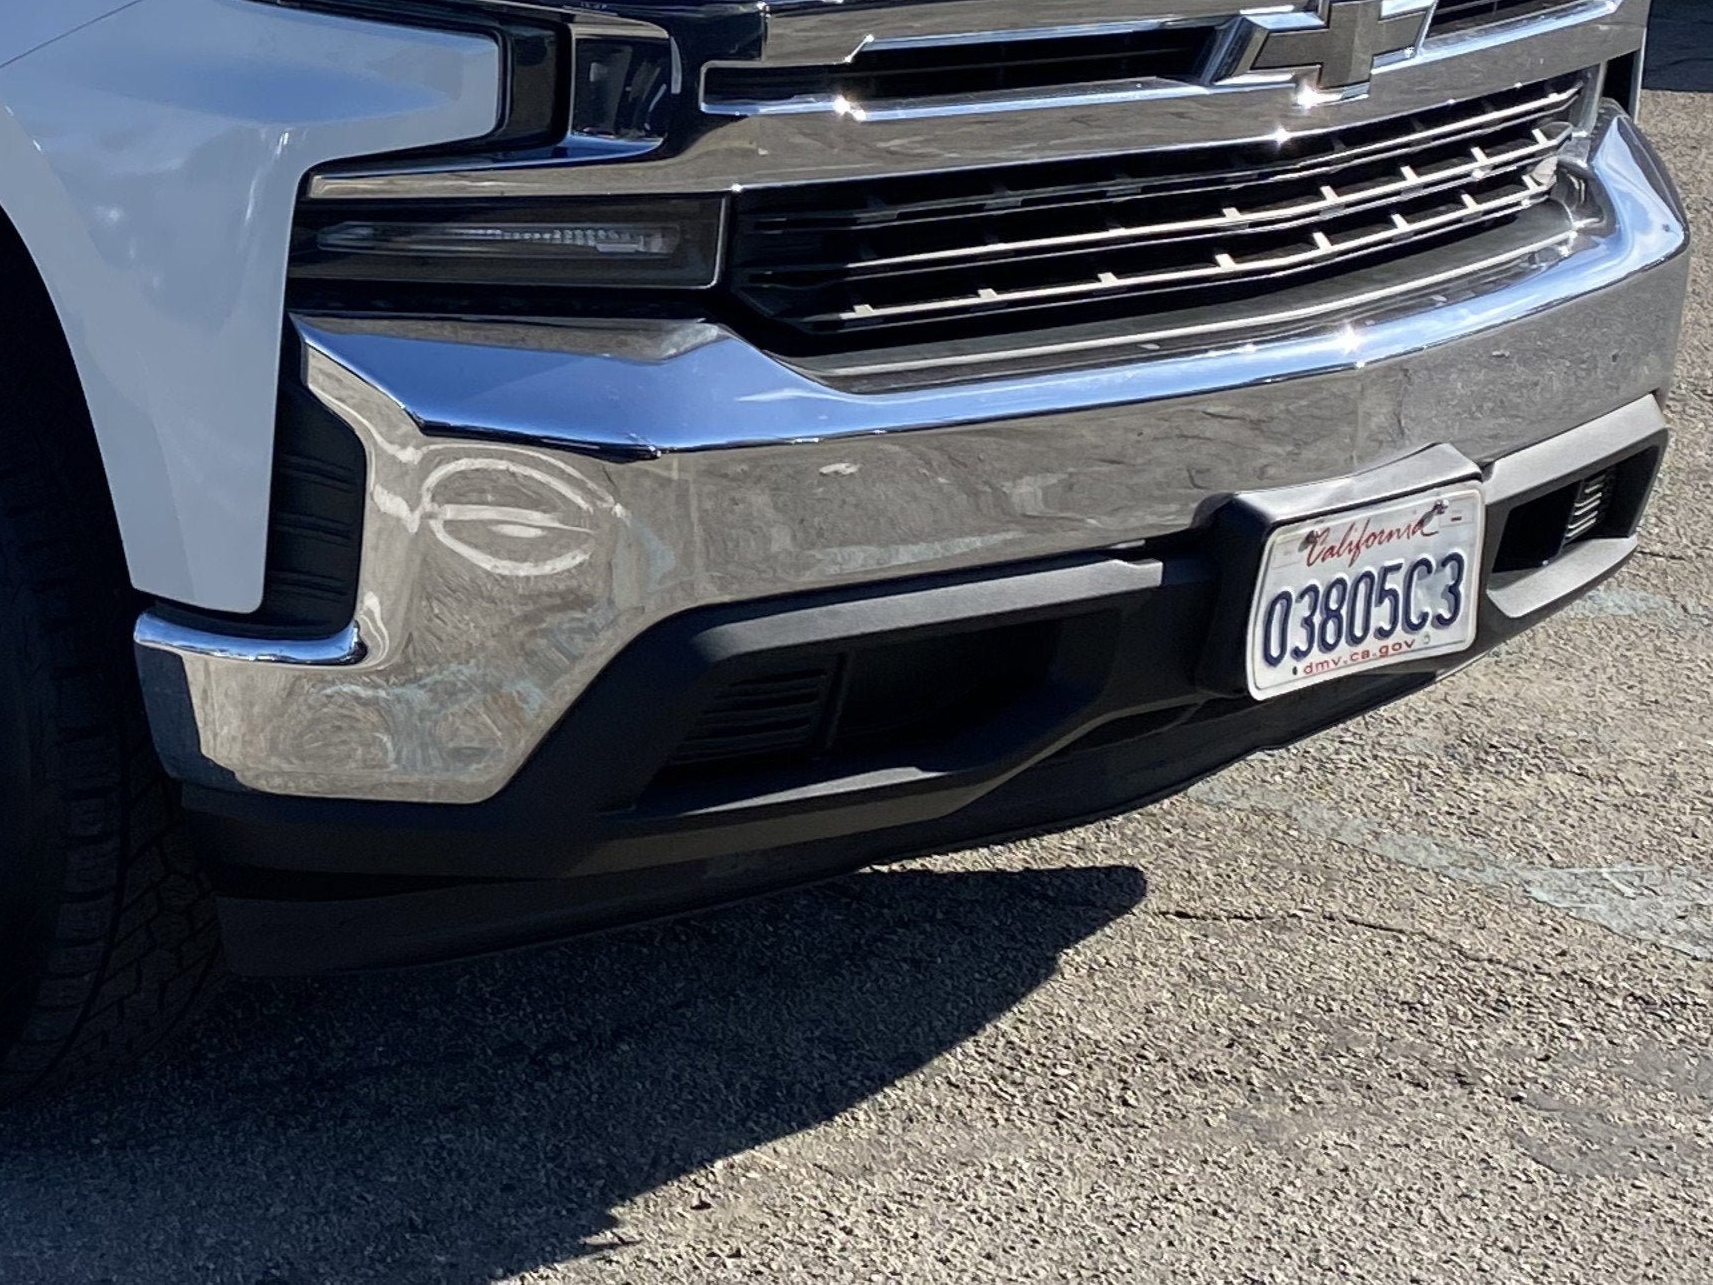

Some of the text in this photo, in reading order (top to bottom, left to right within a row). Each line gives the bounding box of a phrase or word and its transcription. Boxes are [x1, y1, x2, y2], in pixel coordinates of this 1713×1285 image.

[1304, 510, 1439, 567] California
[1263, 551, 1465, 667] 03805C3
[1302, 637, 1417, 676] dmv.ca.gov
